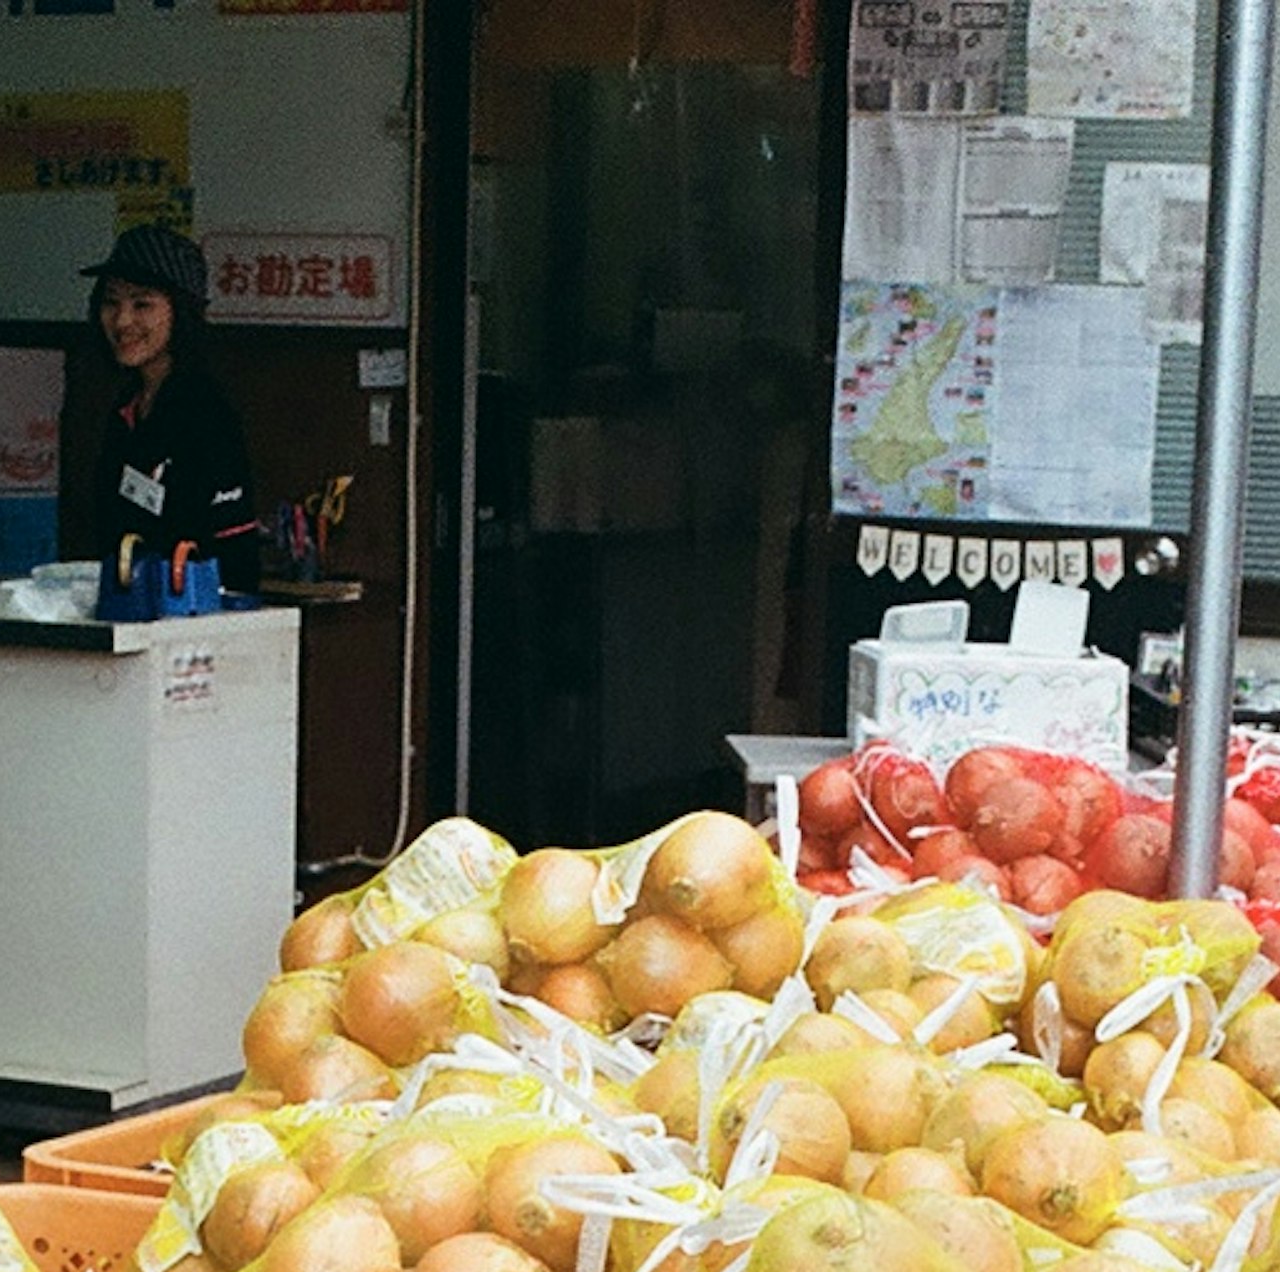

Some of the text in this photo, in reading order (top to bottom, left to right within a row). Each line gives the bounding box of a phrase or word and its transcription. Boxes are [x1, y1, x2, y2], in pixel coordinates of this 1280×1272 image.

[217, 254, 379, 300] お勘定場
[863, 540, 1083, 579] WELCOME
